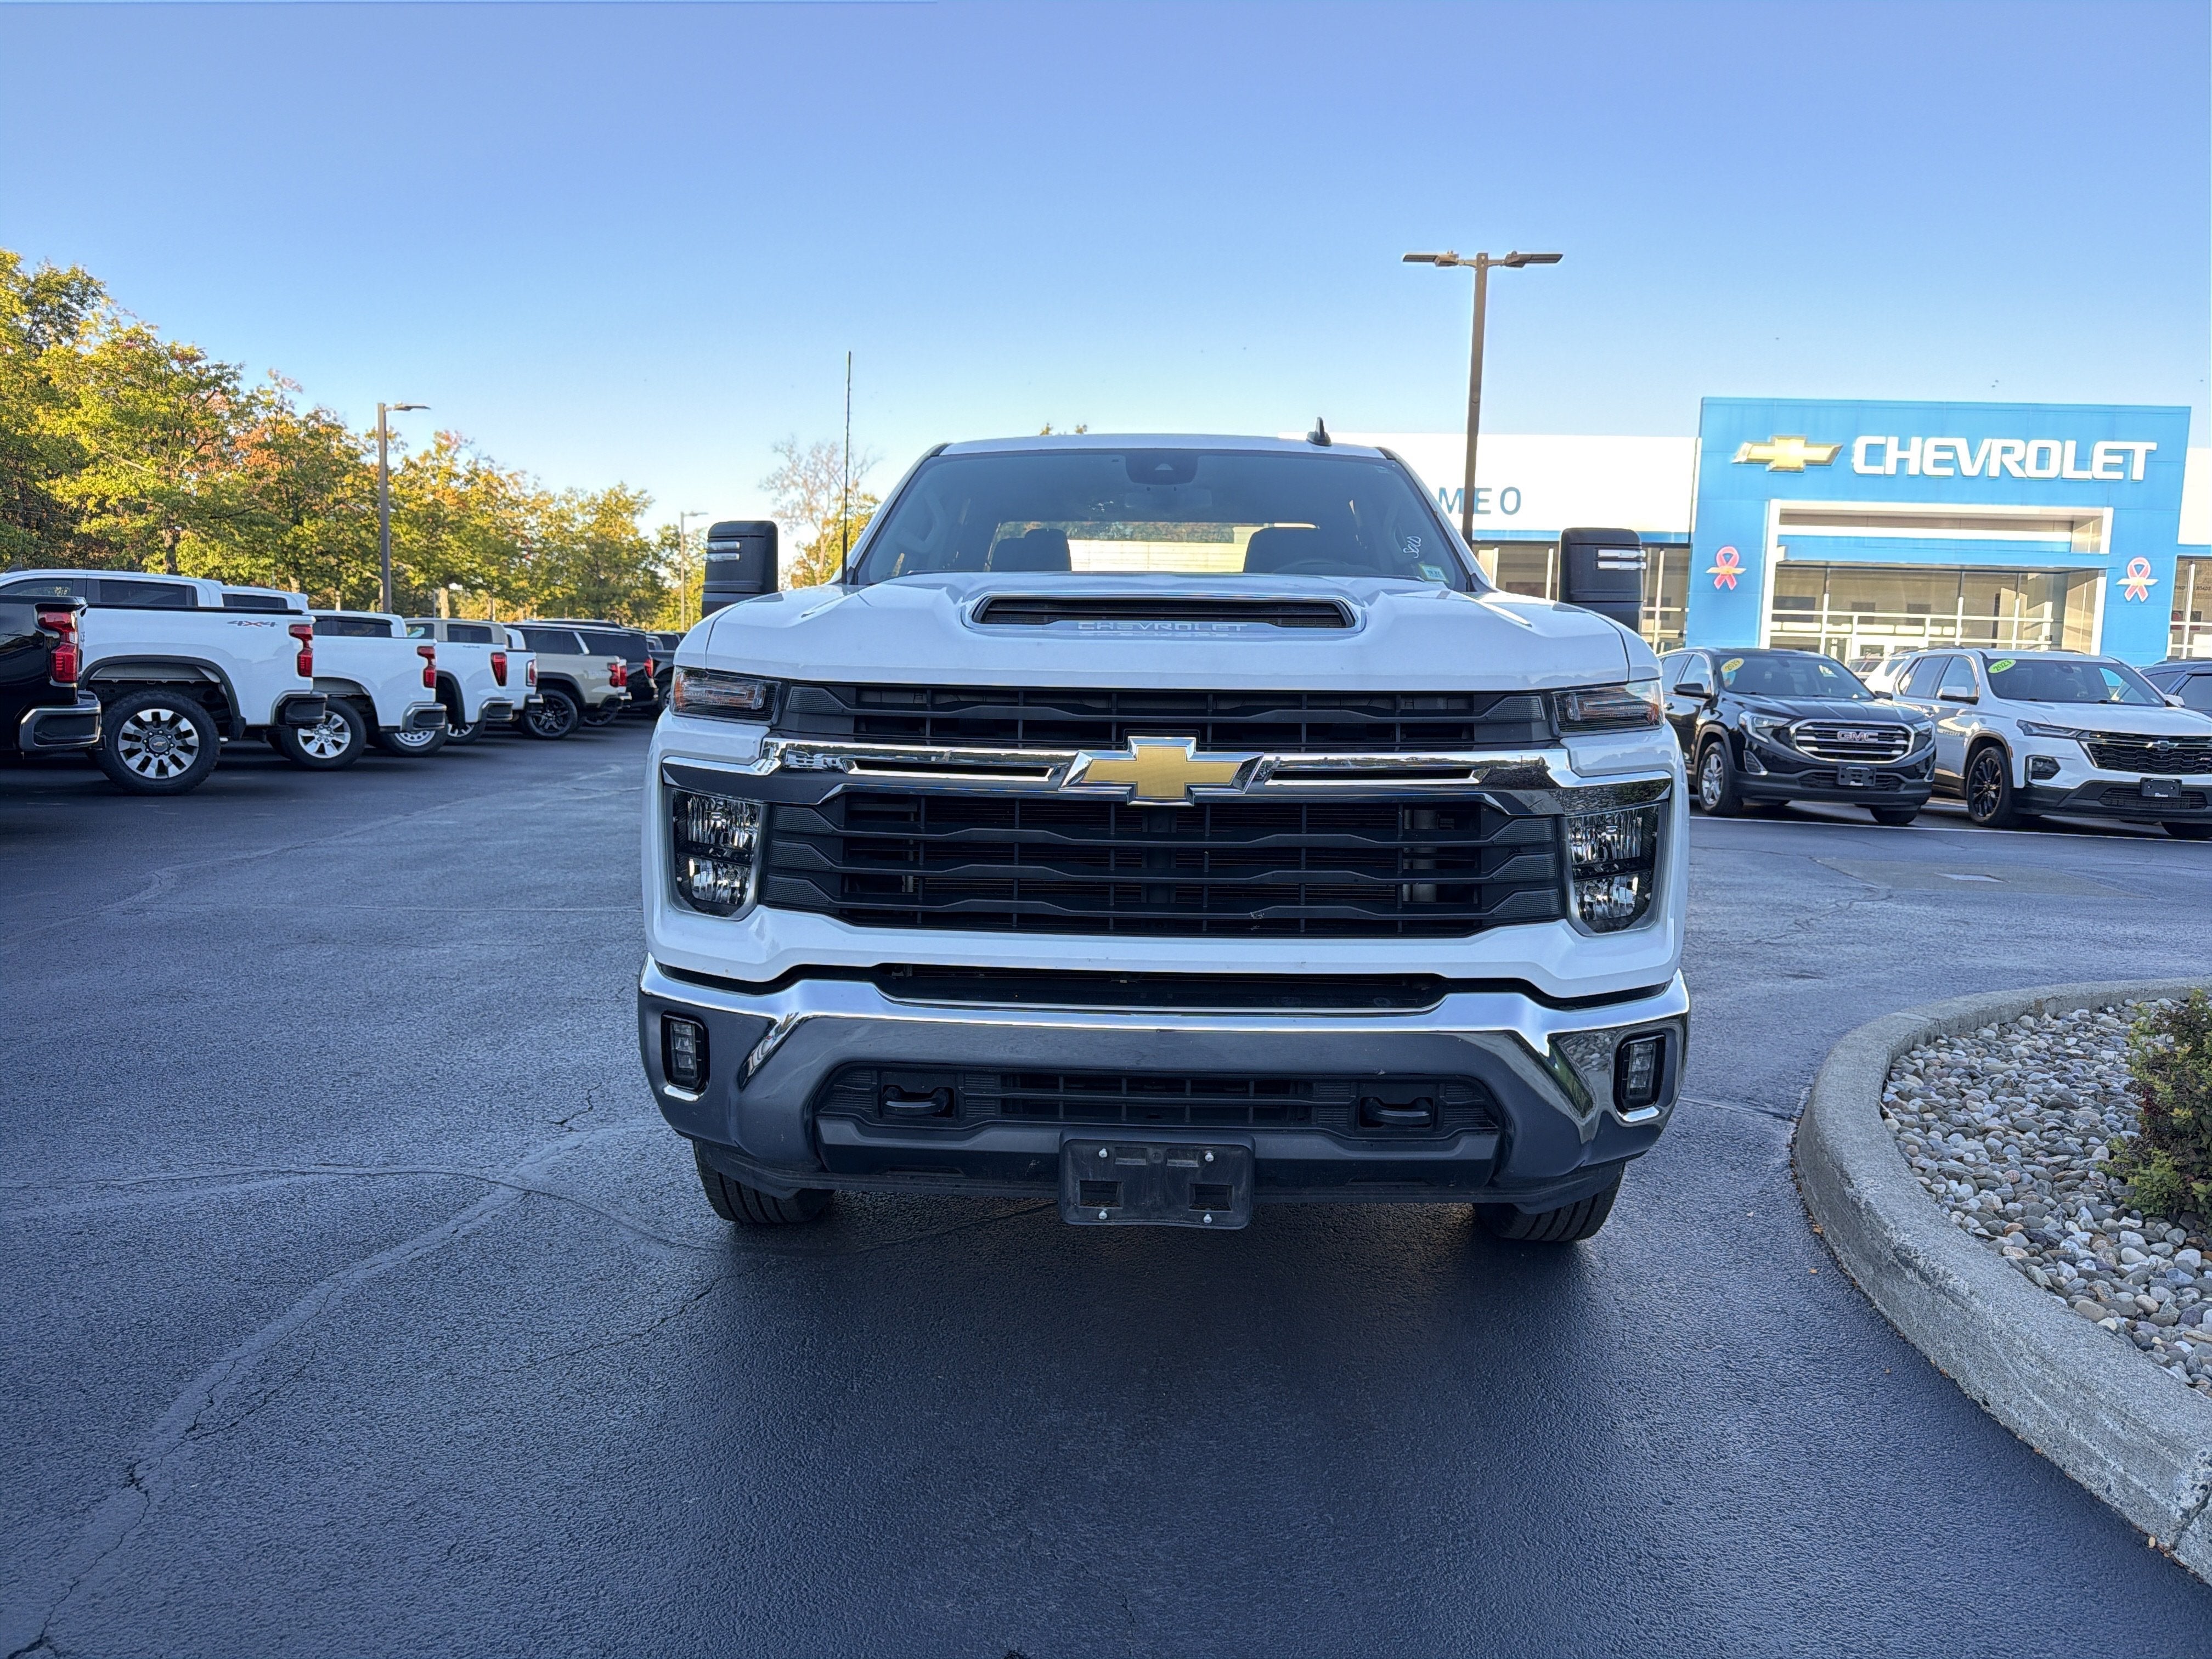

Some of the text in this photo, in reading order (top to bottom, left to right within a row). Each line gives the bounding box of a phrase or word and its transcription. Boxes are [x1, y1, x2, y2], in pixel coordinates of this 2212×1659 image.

[1852, 436, 2158, 481] CHEVROLET
[1078, 621, 1248, 631] CHEVROLET
[1993, 660, 2012, 672] 2023
[1837, 731, 1879, 742] GMC
